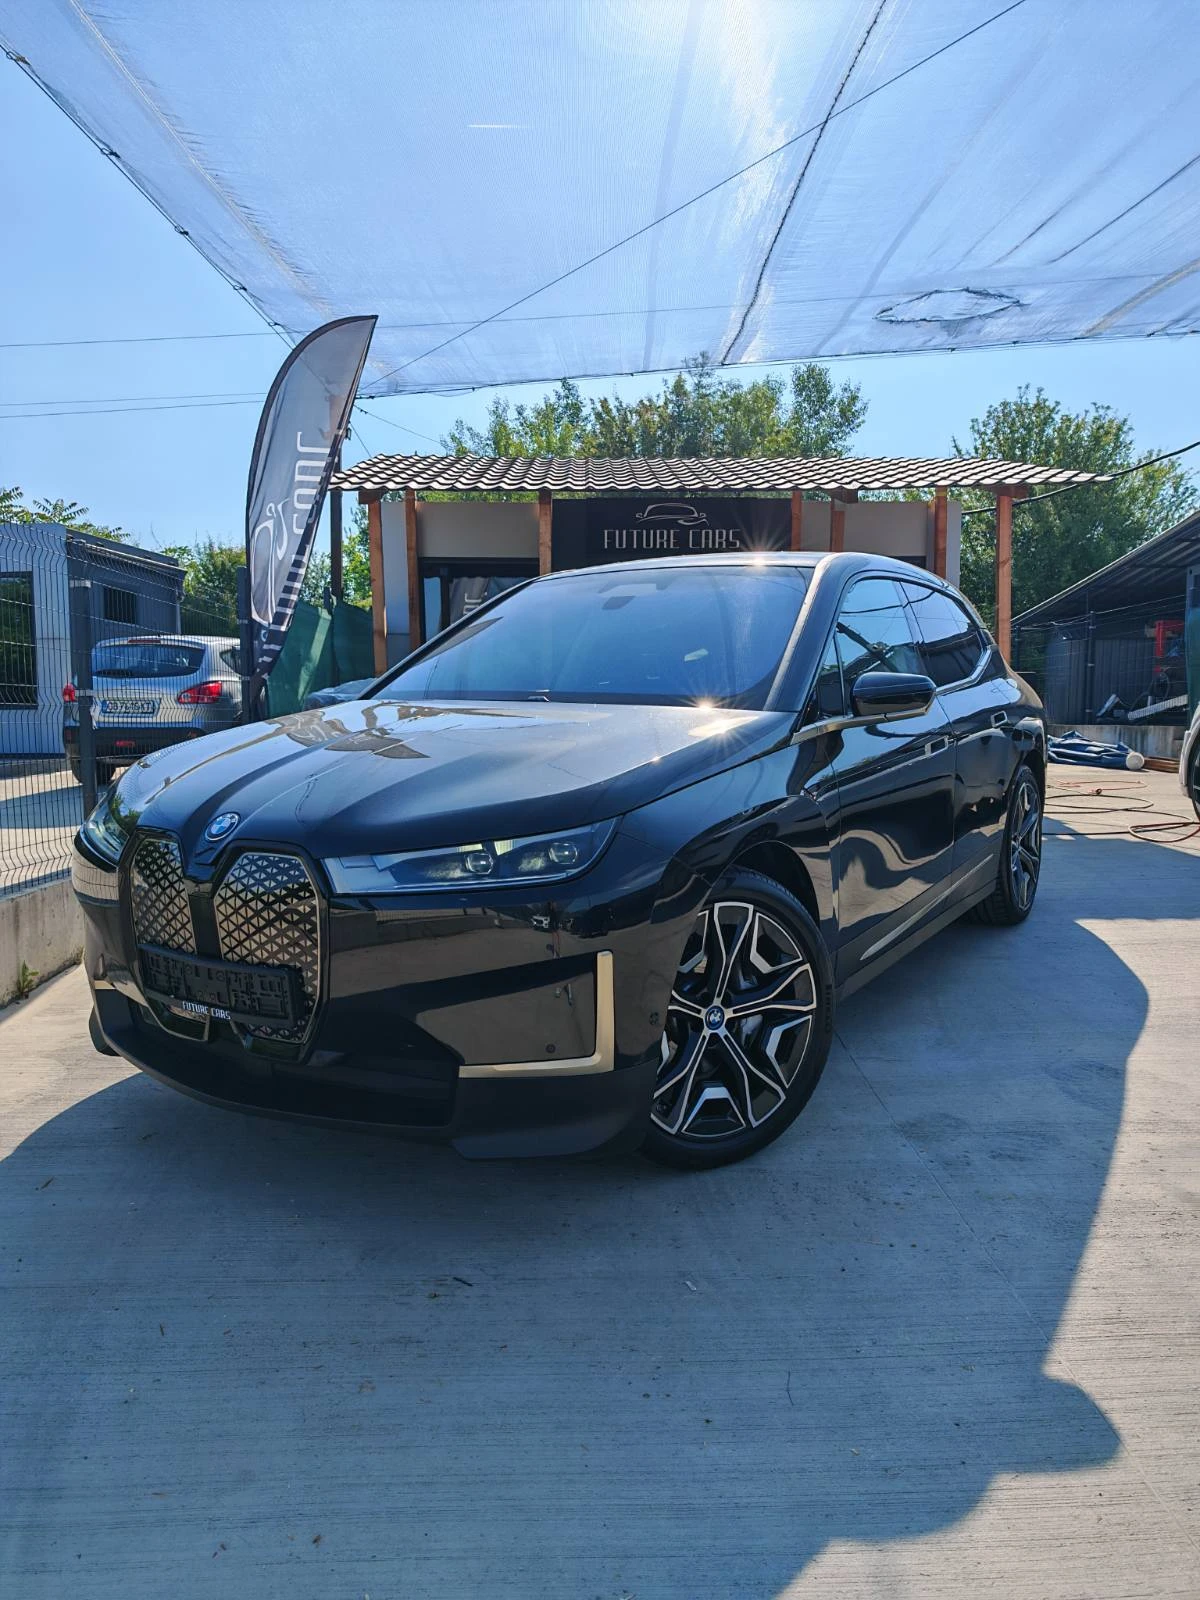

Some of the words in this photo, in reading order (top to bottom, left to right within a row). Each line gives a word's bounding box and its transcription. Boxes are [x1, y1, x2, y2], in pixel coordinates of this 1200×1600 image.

[603, 529, 680, 549] FUTURE
[689, 529, 741, 549] CARS
[182, 1001, 208, 1014] FUTURE
[210, 1008, 230, 1019] CARS
